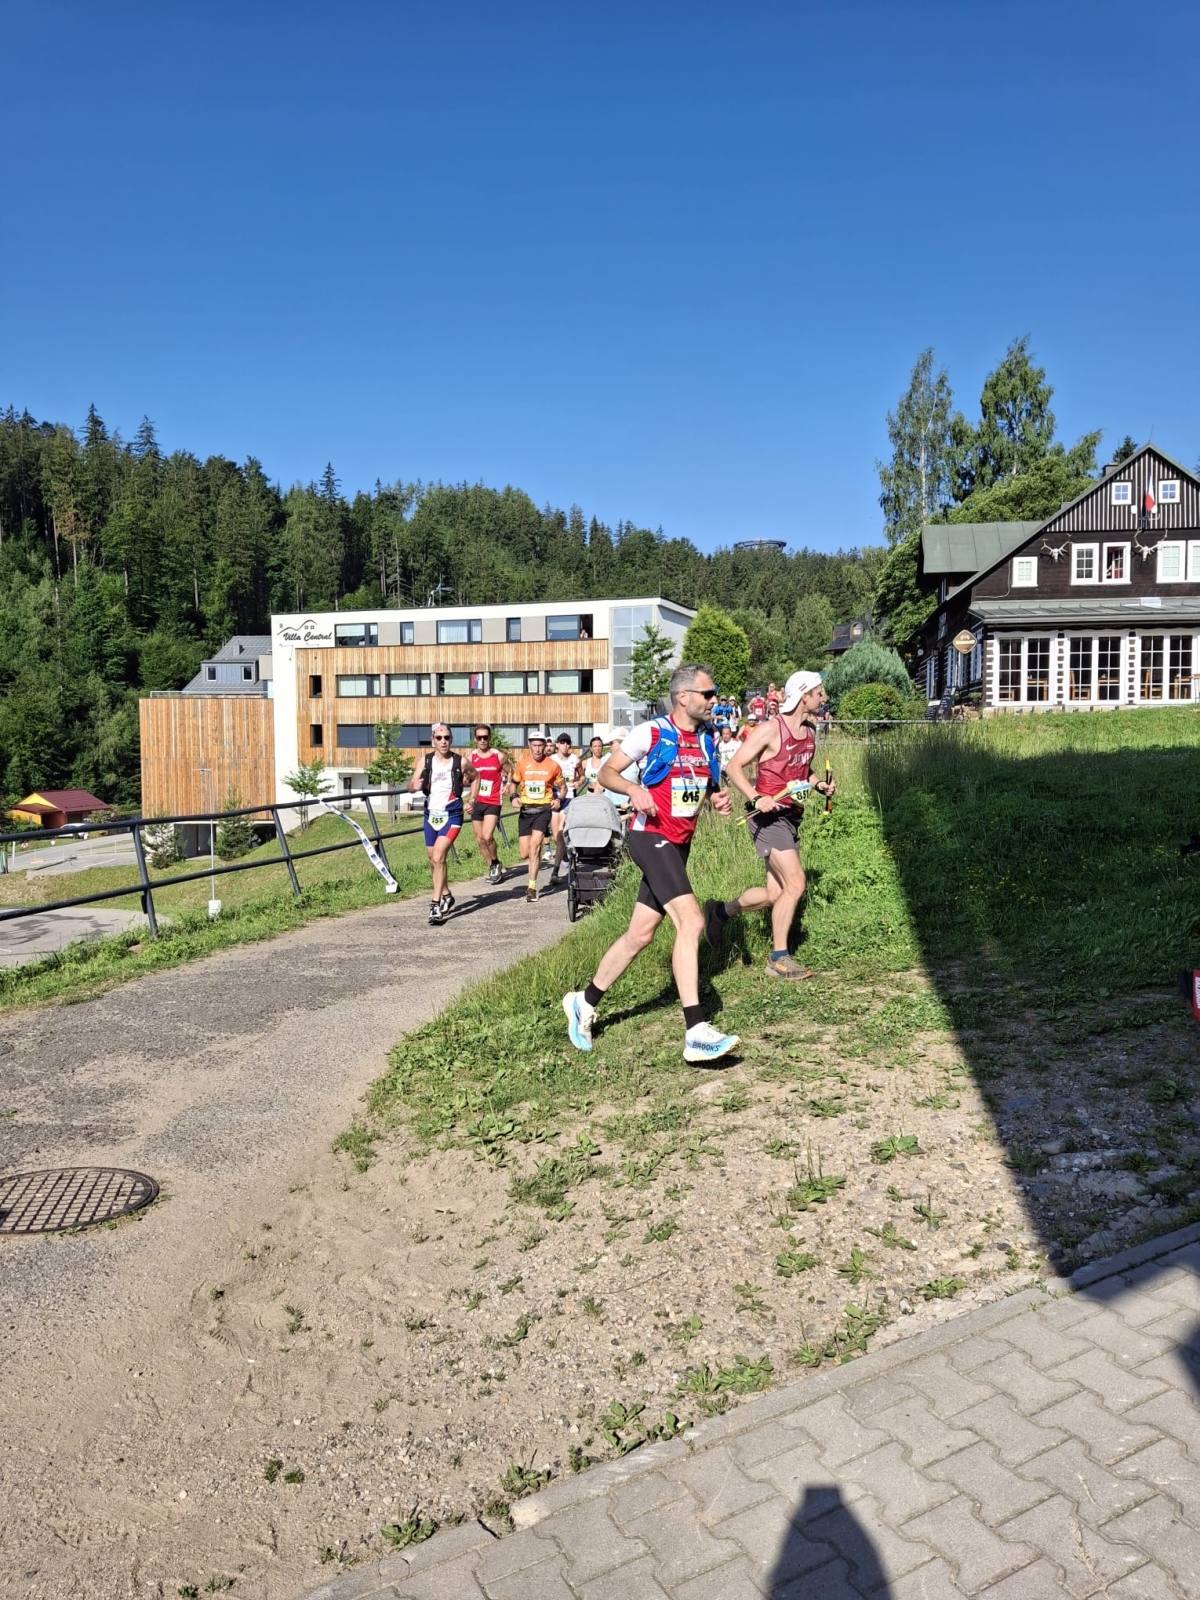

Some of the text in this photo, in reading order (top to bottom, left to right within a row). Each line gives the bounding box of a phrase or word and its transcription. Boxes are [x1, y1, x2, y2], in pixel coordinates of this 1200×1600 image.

[283, 631, 332, 642] Villa Central
[682, 790, 700, 803] 615
[692, 1041, 721, 1052] BROOKS
